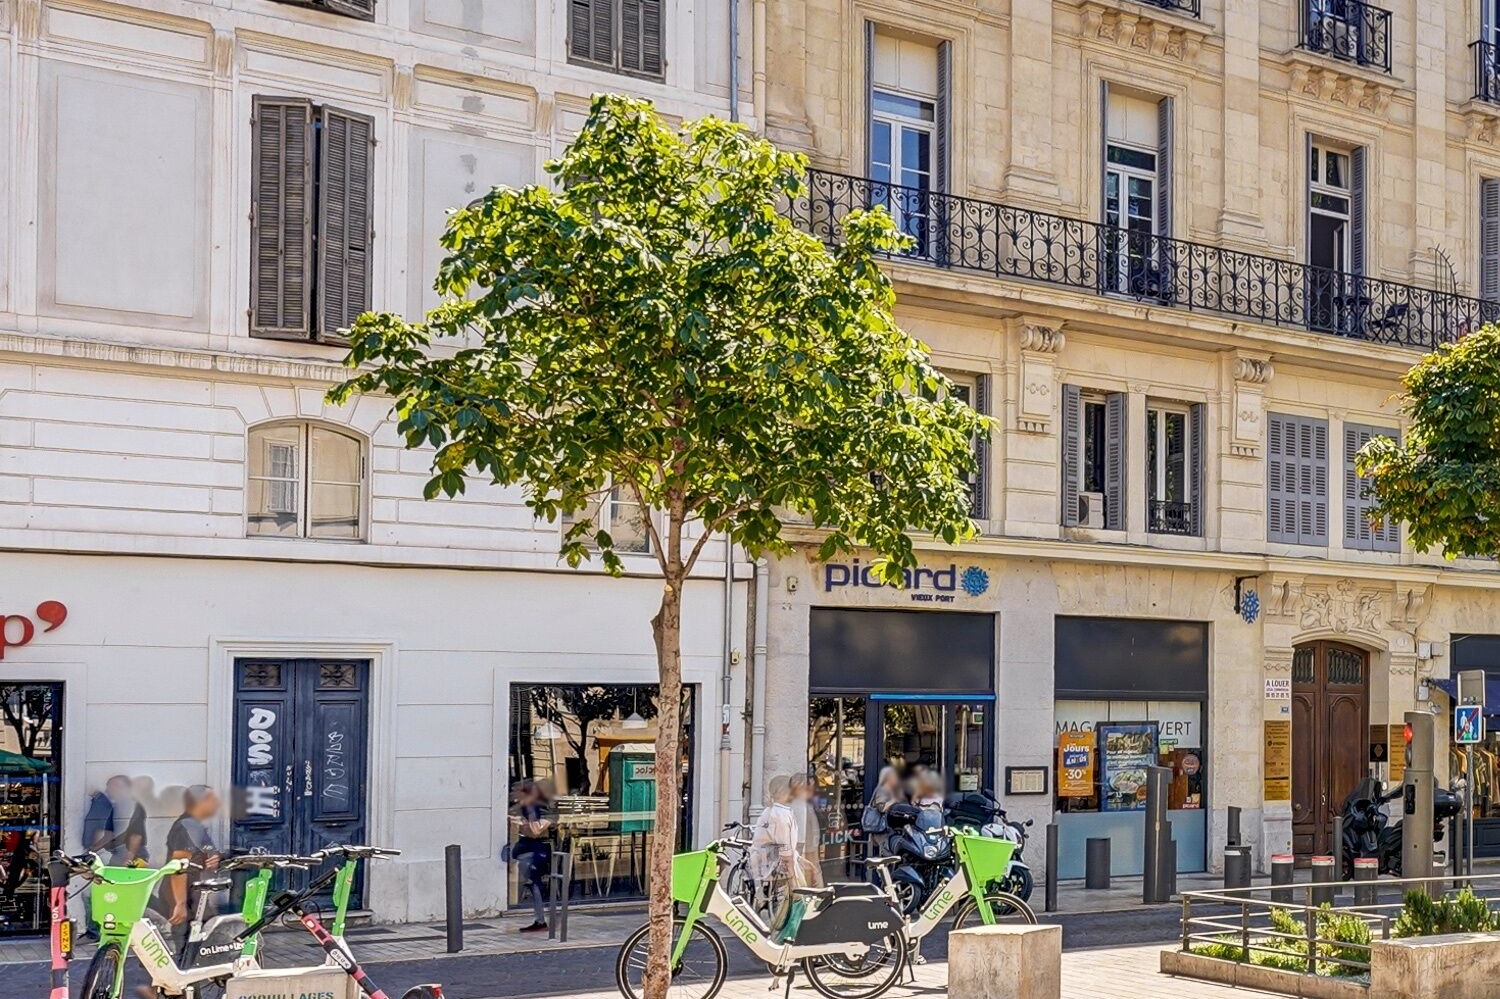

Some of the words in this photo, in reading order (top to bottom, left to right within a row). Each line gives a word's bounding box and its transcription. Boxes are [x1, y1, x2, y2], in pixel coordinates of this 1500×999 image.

[935, 595, 955, 603] PORT
[924, 890, 954, 921] Lime
[724, 909, 758, 944] Lime
[142, 932, 169, 969] Lime
[200, 947, 212, 956] On
[212, 944, 230, 954] Lime
